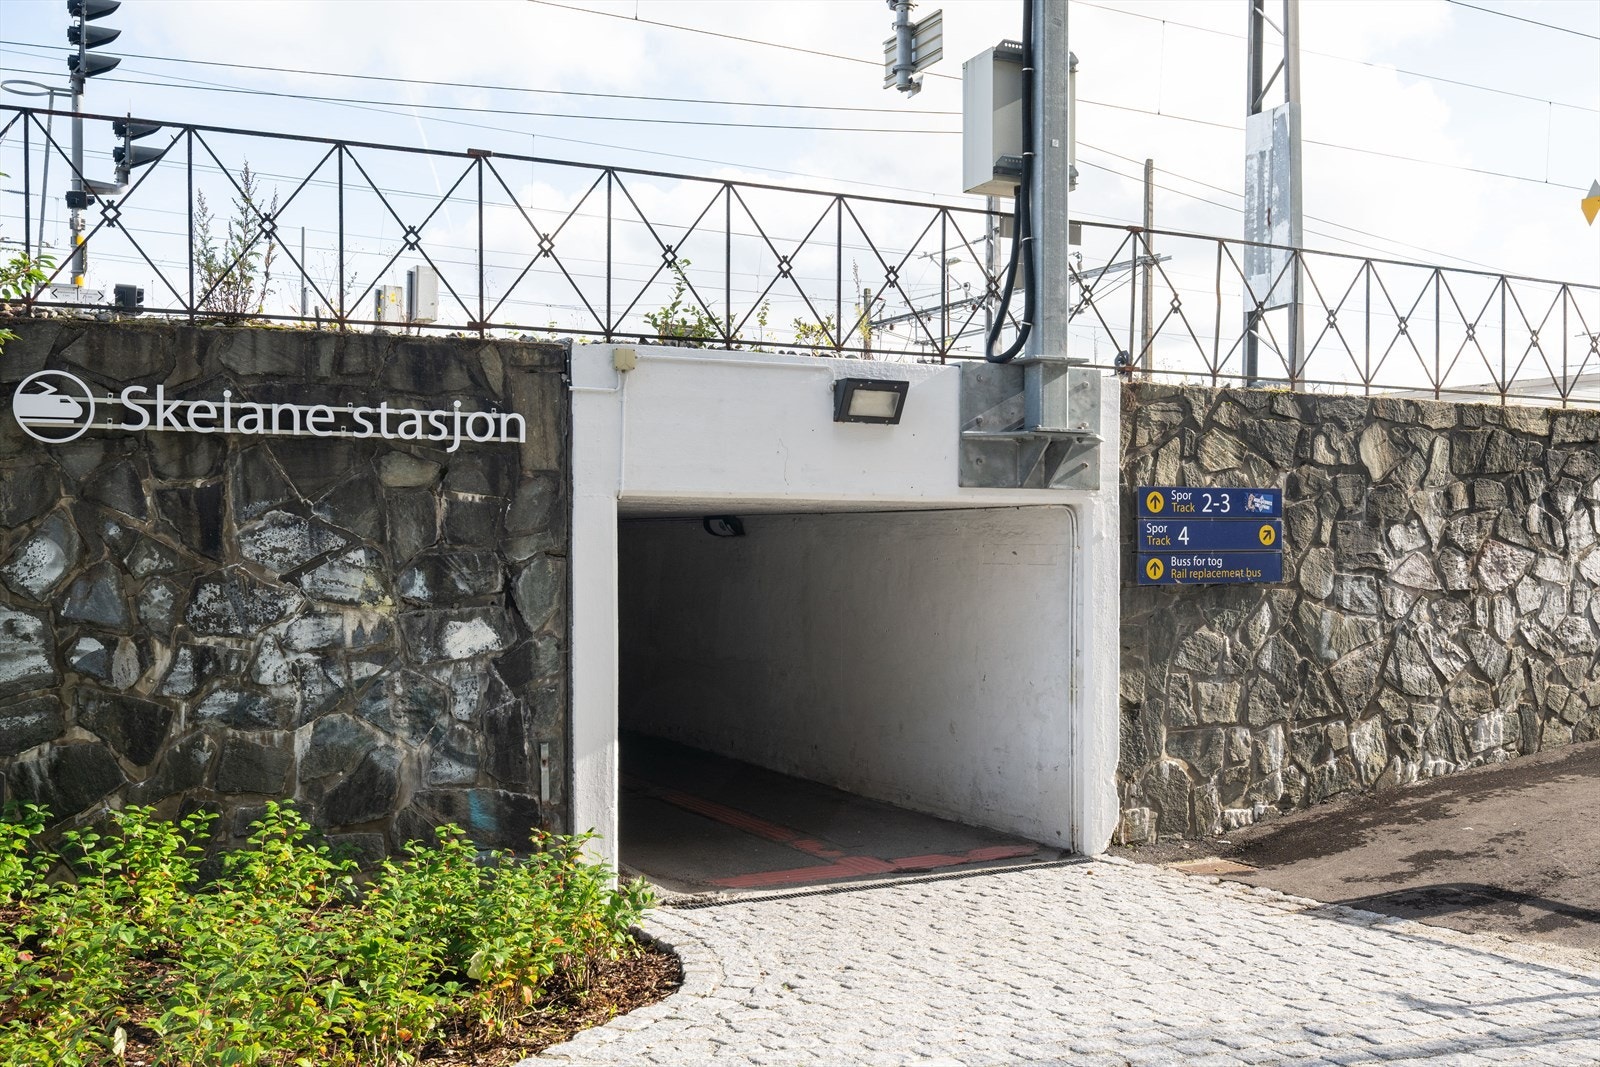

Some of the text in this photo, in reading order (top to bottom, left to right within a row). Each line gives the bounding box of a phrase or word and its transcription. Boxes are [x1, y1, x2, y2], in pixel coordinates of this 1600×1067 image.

[120, 385, 526, 452] Skeiane stasjon
[1171, 490, 1230, 513] Spor 2-3
[1172, 502, 1195, 513] Track
[1146, 523, 1189, 545] Spor 4
[1147, 536, 1171, 546] Track
[1171, 556, 1223, 568] Buss for tog
[1171, 568, 1261, 580] Rail replacement bus
